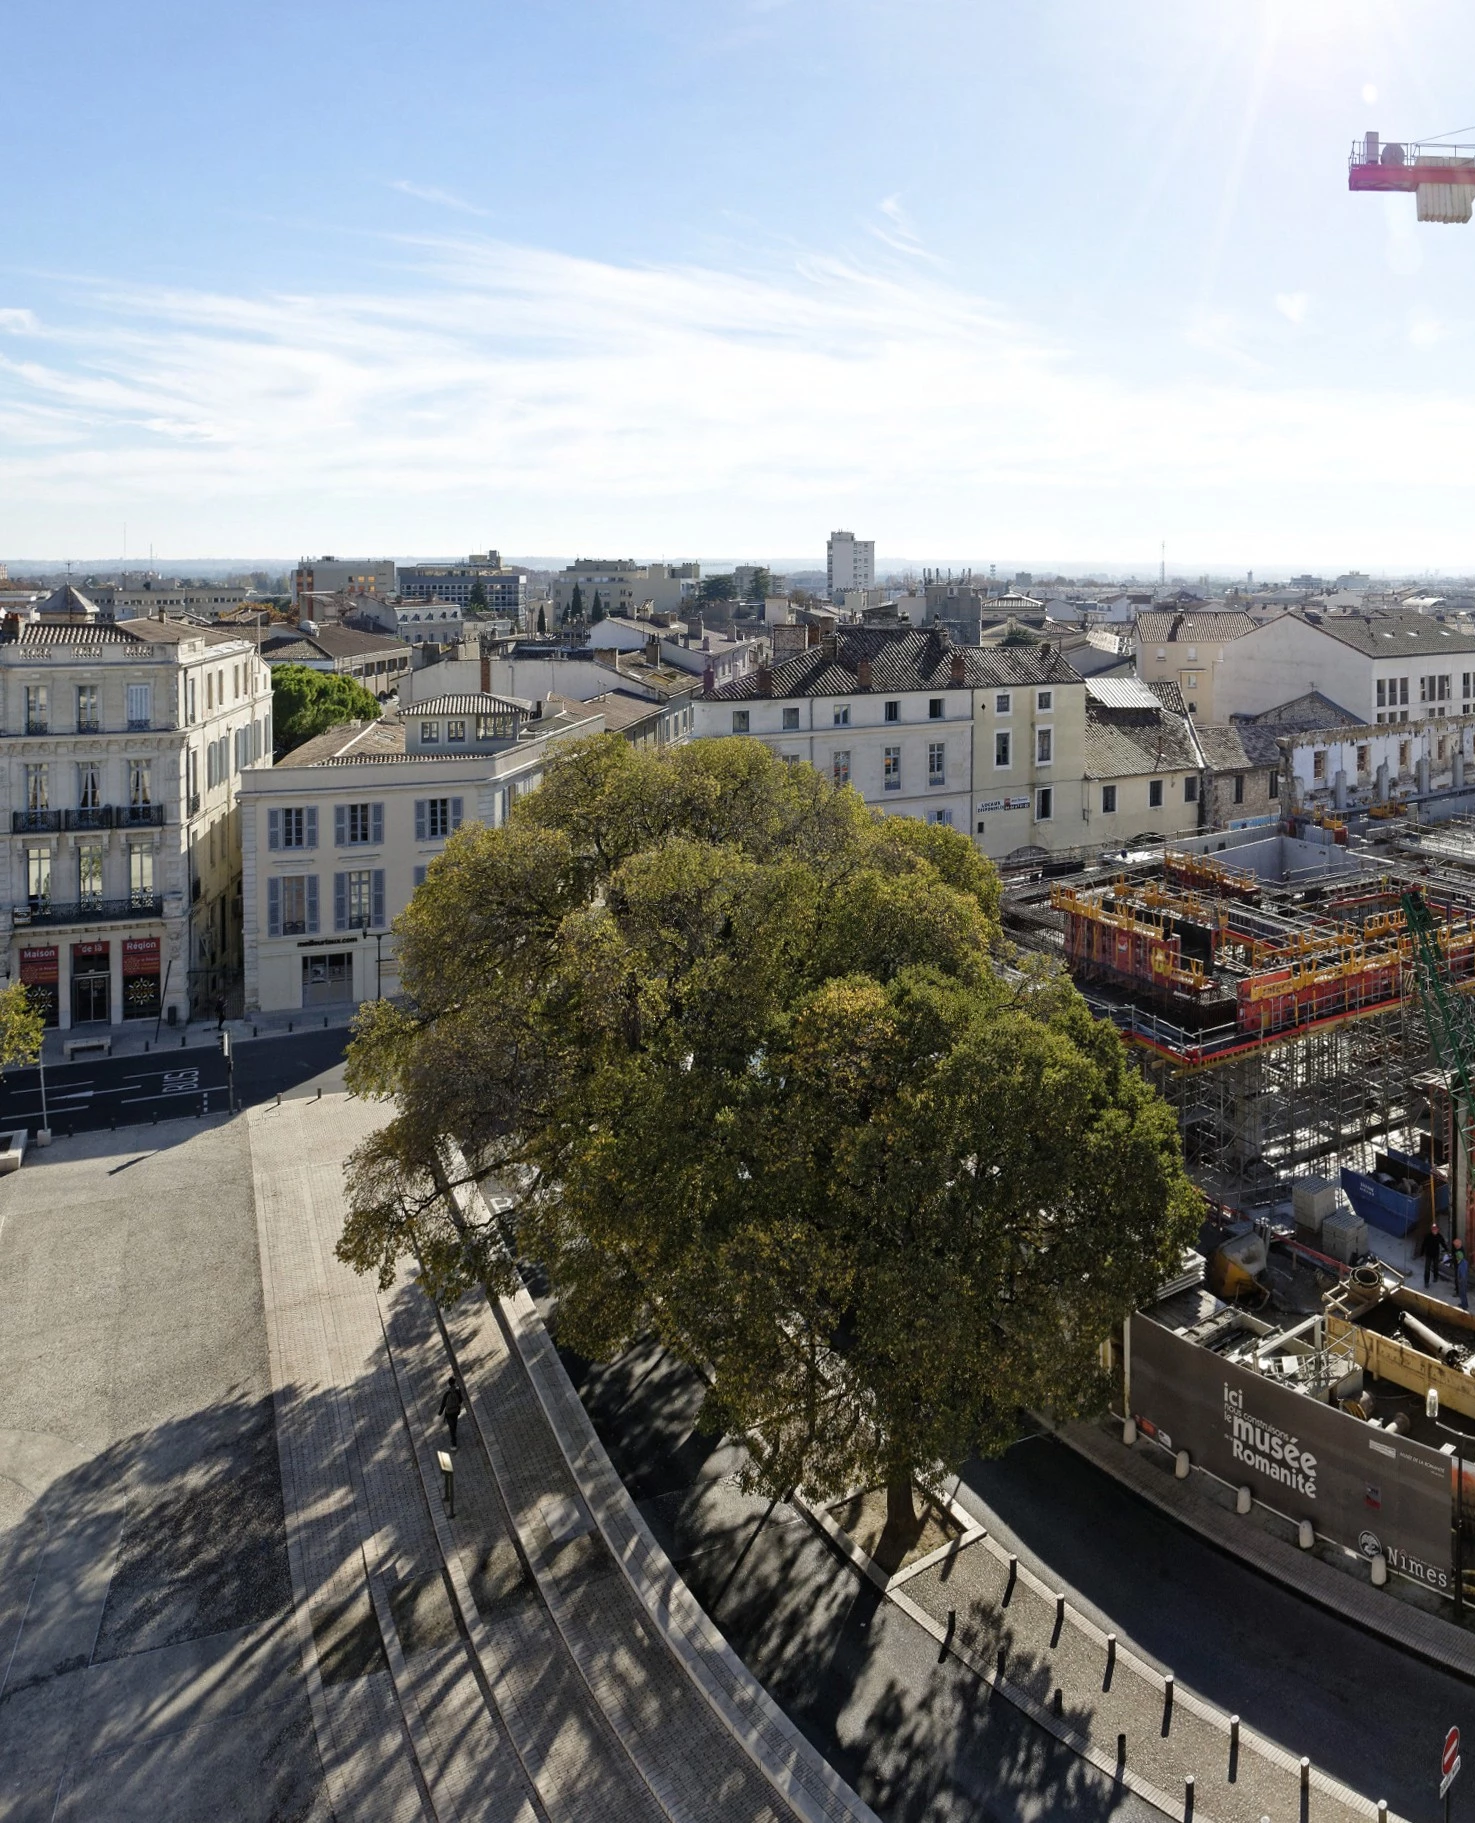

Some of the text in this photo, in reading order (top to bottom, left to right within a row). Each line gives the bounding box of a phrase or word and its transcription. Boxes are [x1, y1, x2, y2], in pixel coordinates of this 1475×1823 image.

[24, 949, 55, 959] Maison
[82, 944, 92, 953] de
[126, 941, 157, 951] Région
[162, 1070, 200, 1093] BUS
[1224, 1382, 1243, 1409] ici
[1224, 1403, 1289, 1441] nous construisons
[1224, 1411, 1317, 1477] le musée
[1233, 1437, 1317, 1498] Romanité
